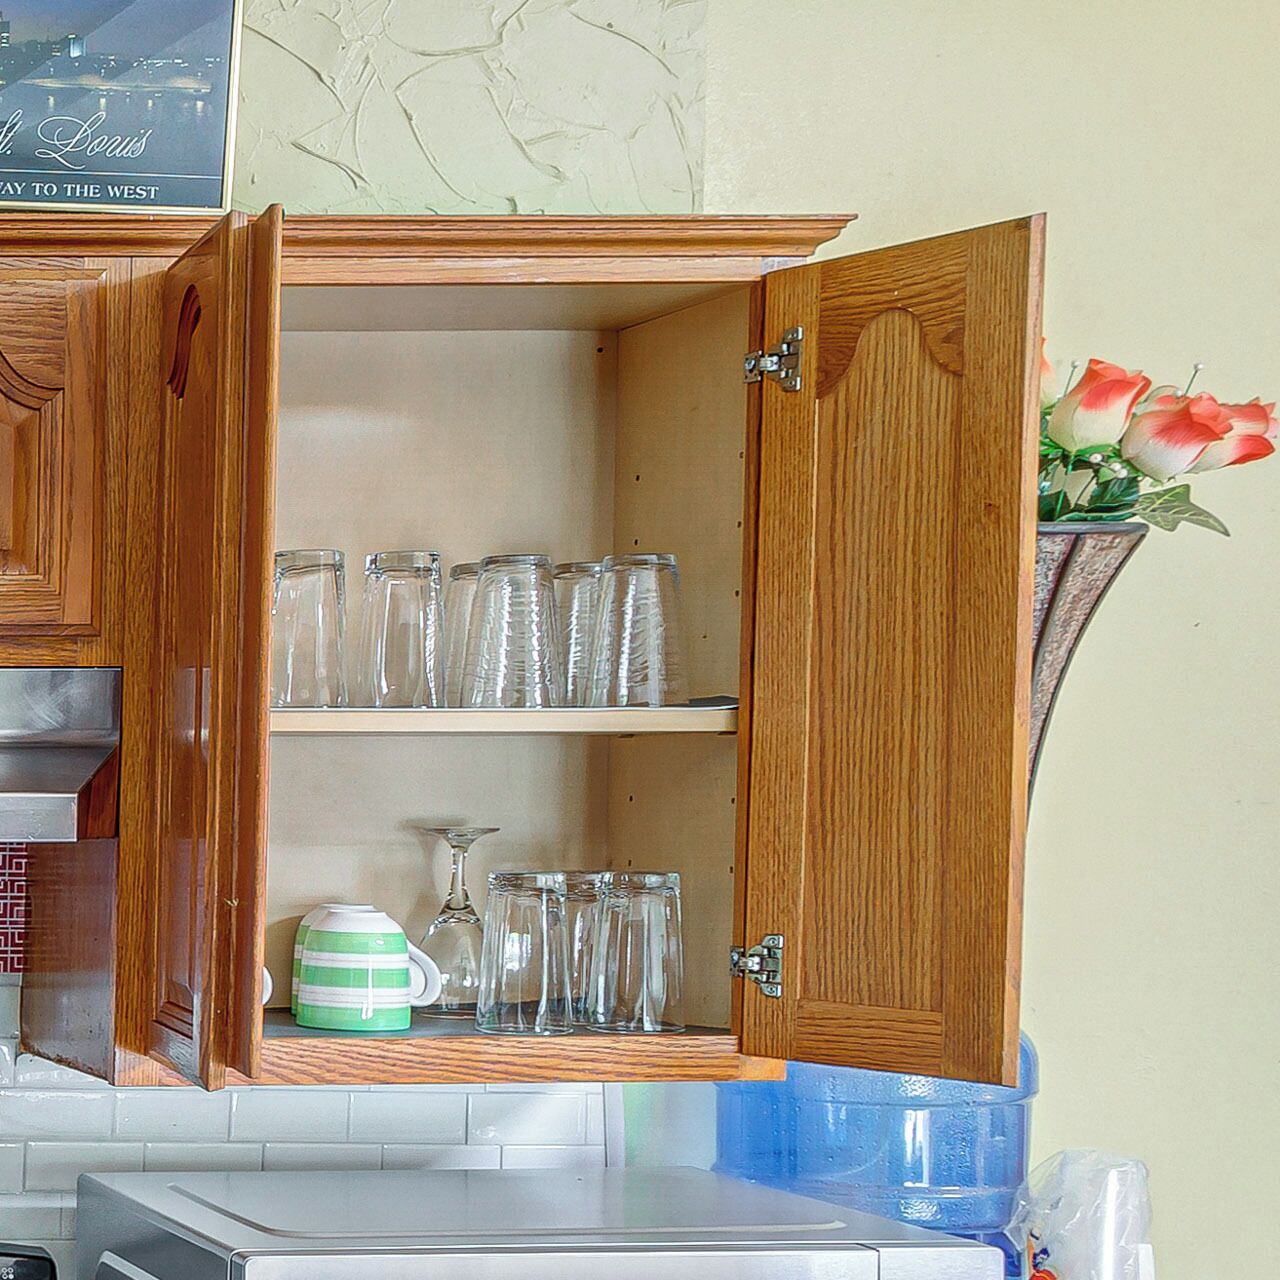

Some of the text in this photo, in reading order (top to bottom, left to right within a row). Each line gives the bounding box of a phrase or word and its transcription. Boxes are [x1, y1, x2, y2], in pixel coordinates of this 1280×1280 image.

[35, 111, 153, 169] Louis
[31, 182, 58, 197] TO
[63, 184, 101, 198] THE
[107, 185, 160, 199] WEST
